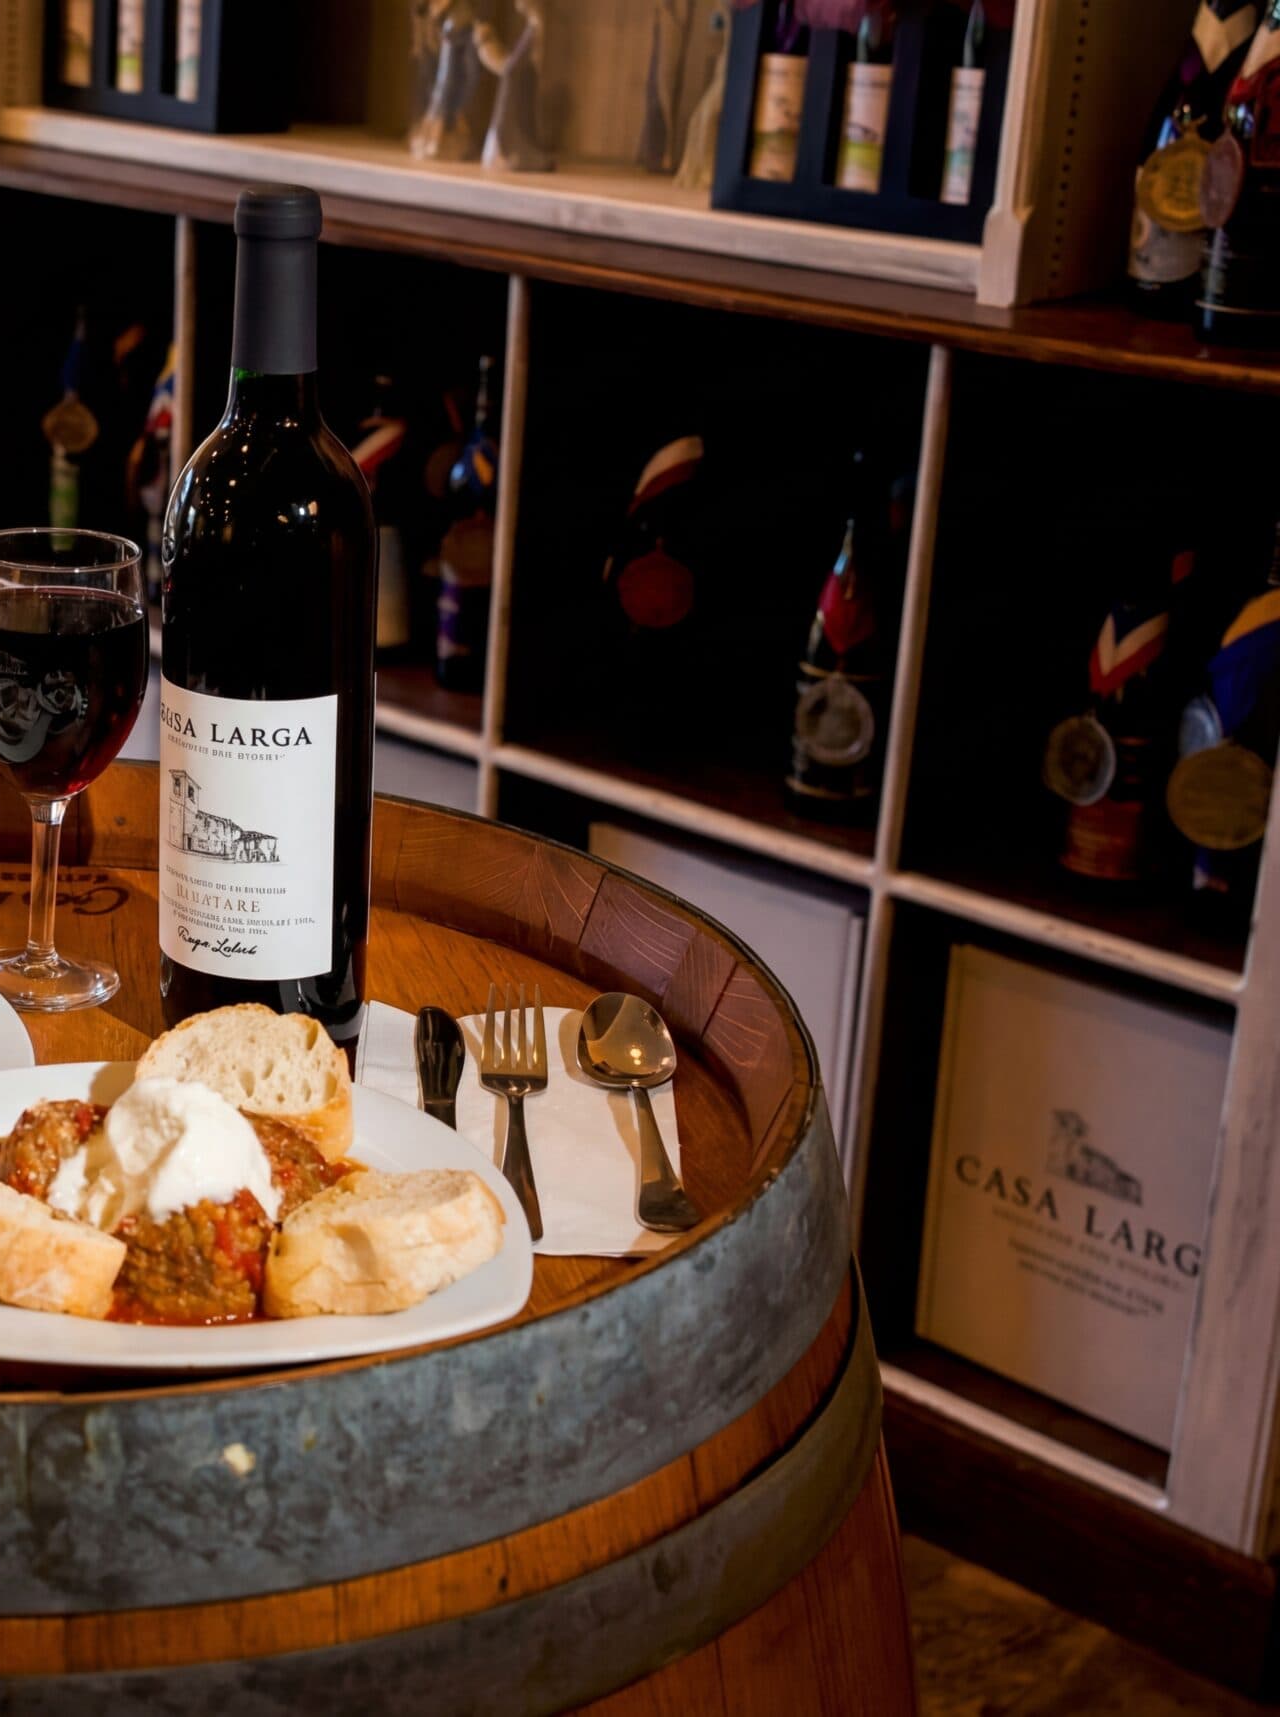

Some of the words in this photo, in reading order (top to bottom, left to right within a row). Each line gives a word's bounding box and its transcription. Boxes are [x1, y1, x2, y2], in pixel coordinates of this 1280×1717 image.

[211, 723, 312, 747] LARGA
[955, 1154, 1058, 1220] CASA
[1085, 1204, 1202, 1277] LARG
